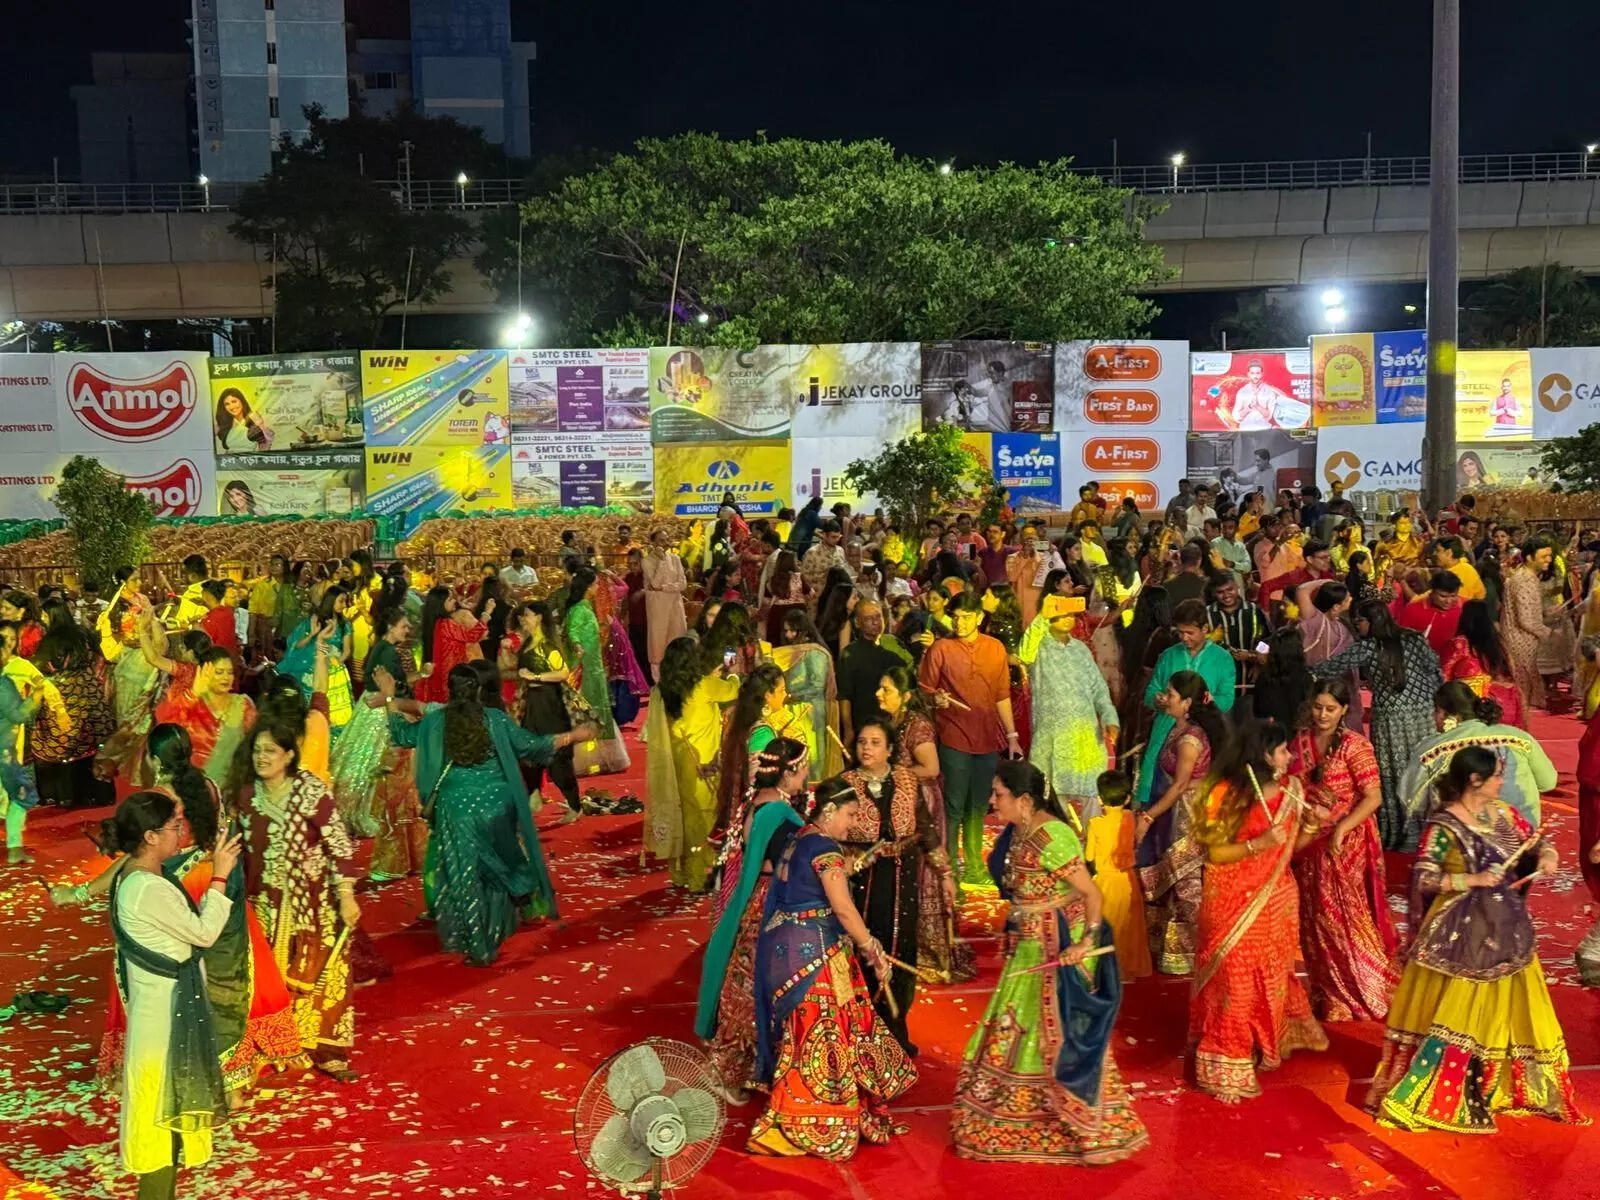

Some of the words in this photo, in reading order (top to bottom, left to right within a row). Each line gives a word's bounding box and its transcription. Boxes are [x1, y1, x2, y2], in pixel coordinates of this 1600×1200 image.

[532, 351, 563, 359] SMTC
[565, 350, 593, 358] STEEL
[0, 377, 29, 386] TINGS
[31, 376, 51, 386] LTD.
[74, 380, 195, 412] Anmol
[821, 385, 869, 399] JEKAY
[870, 384, 922, 398] GROUP
[370, 392, 405, 416] SHARP
[1089, 399, 1122, 412] FIRST
[1126, 399, 1154, 412] BABY
[38, 424, 55, 432] LTD.
[535, 446, 564, 454] SMTC
[566, 445, 596, 453] STEEL
[998, 446, 1055, 469] Satya
[1000, 469, 1053, 477] Steel
[674, 481, 775, 493] Adhunik
[823, 477, 859, 490] JEKA
[374, 488, 408, 512] SHARP
[701, 494, 721, 502] TMT
[686, 505, 719, 513] BHAROS
